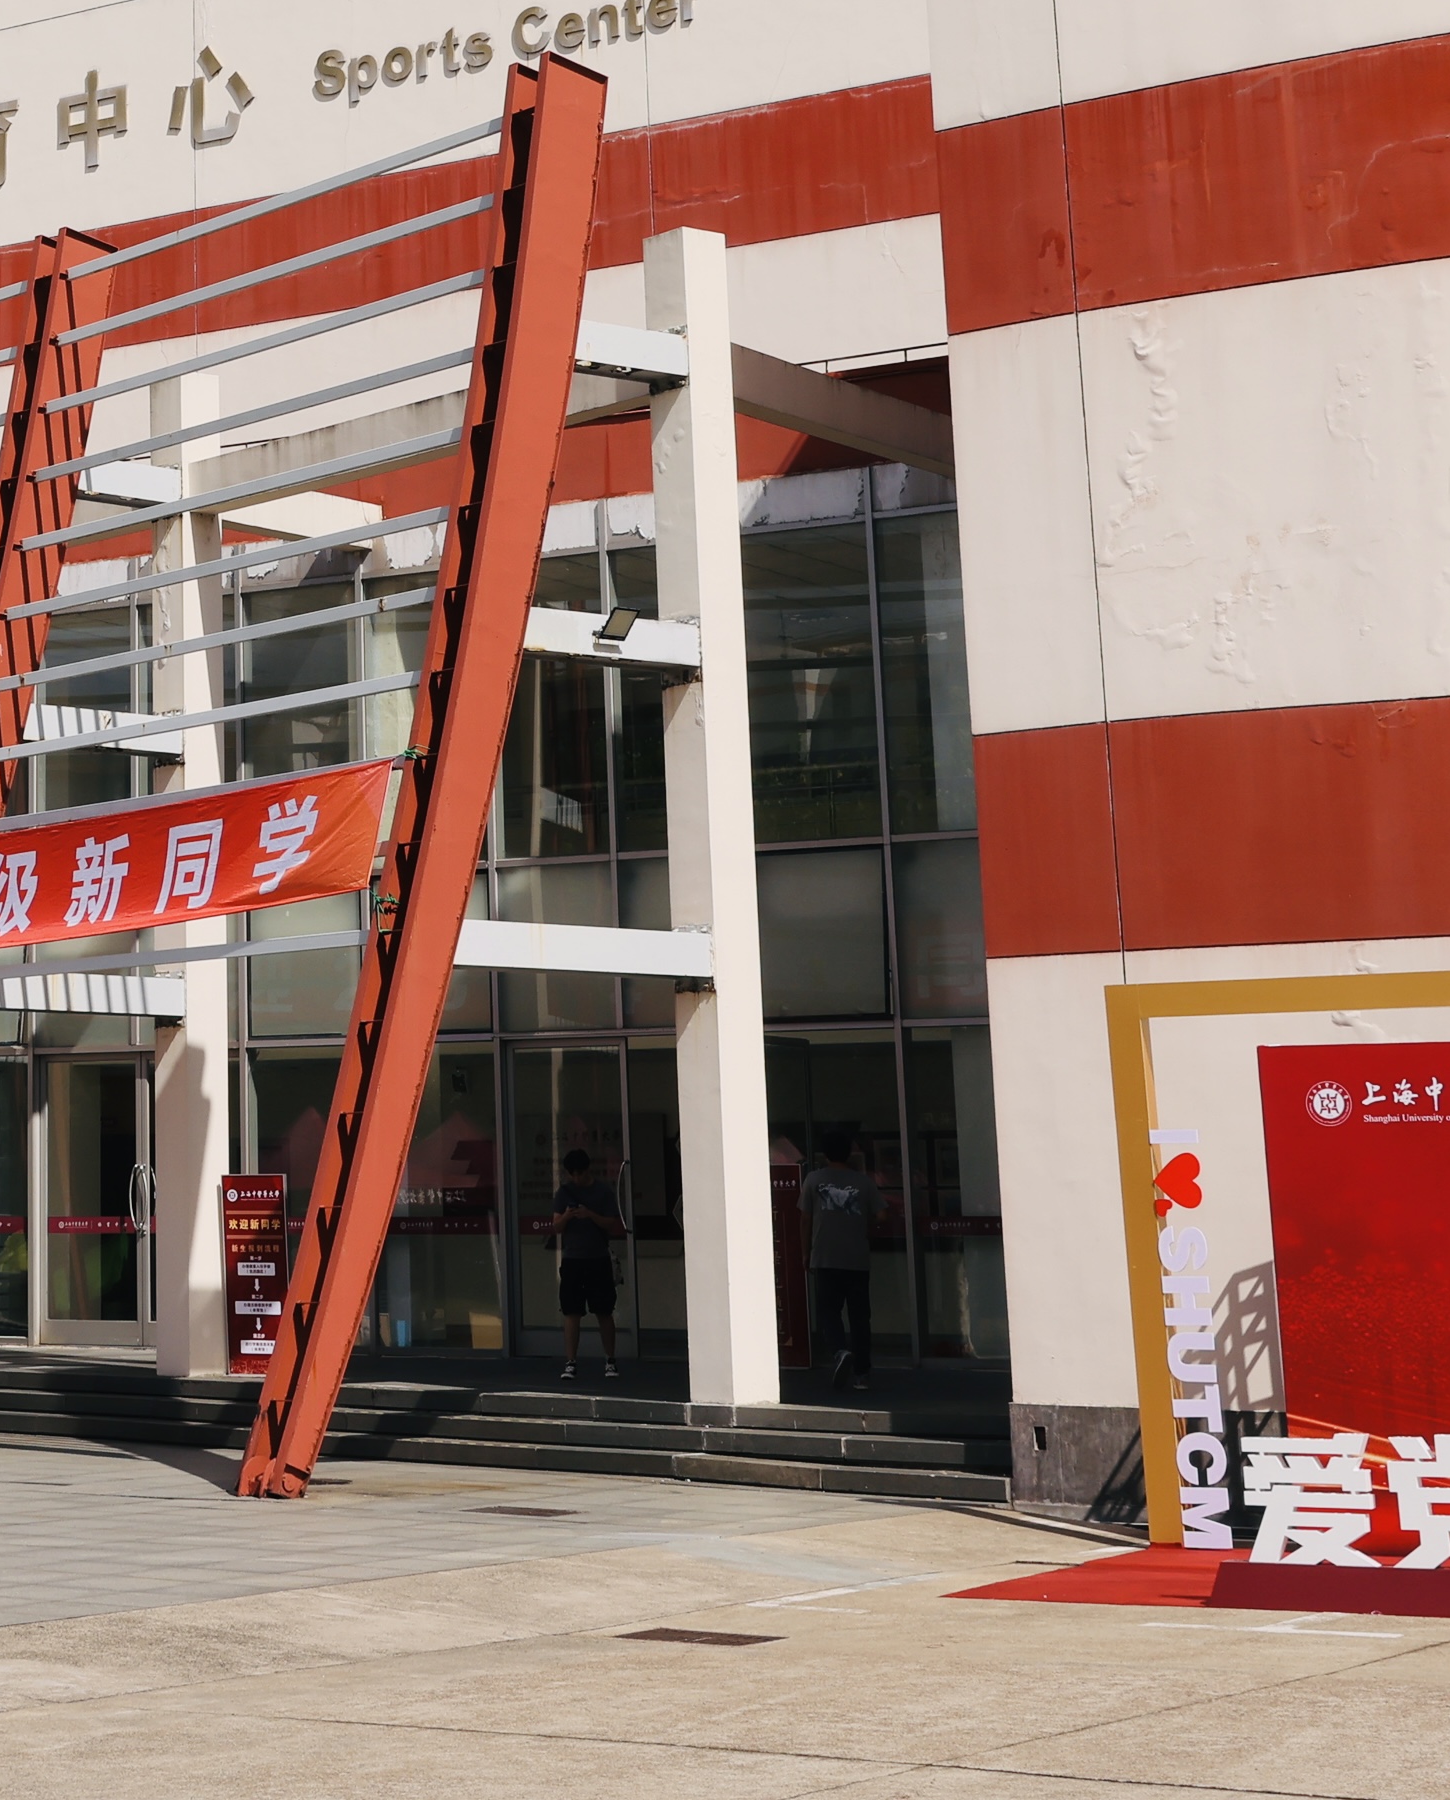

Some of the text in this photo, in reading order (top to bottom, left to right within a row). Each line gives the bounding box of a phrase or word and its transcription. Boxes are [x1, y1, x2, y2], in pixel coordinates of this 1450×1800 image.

[313, 26, 495, 105] Sports
[1363, 1113, 1401, 1124] Shanghai
[1402, 1112, 1444, 1124] University
[228, 1218, 281, 1230] 欢迎新同学
[1148, 1128, 1234, 1550] I SHUTCM
